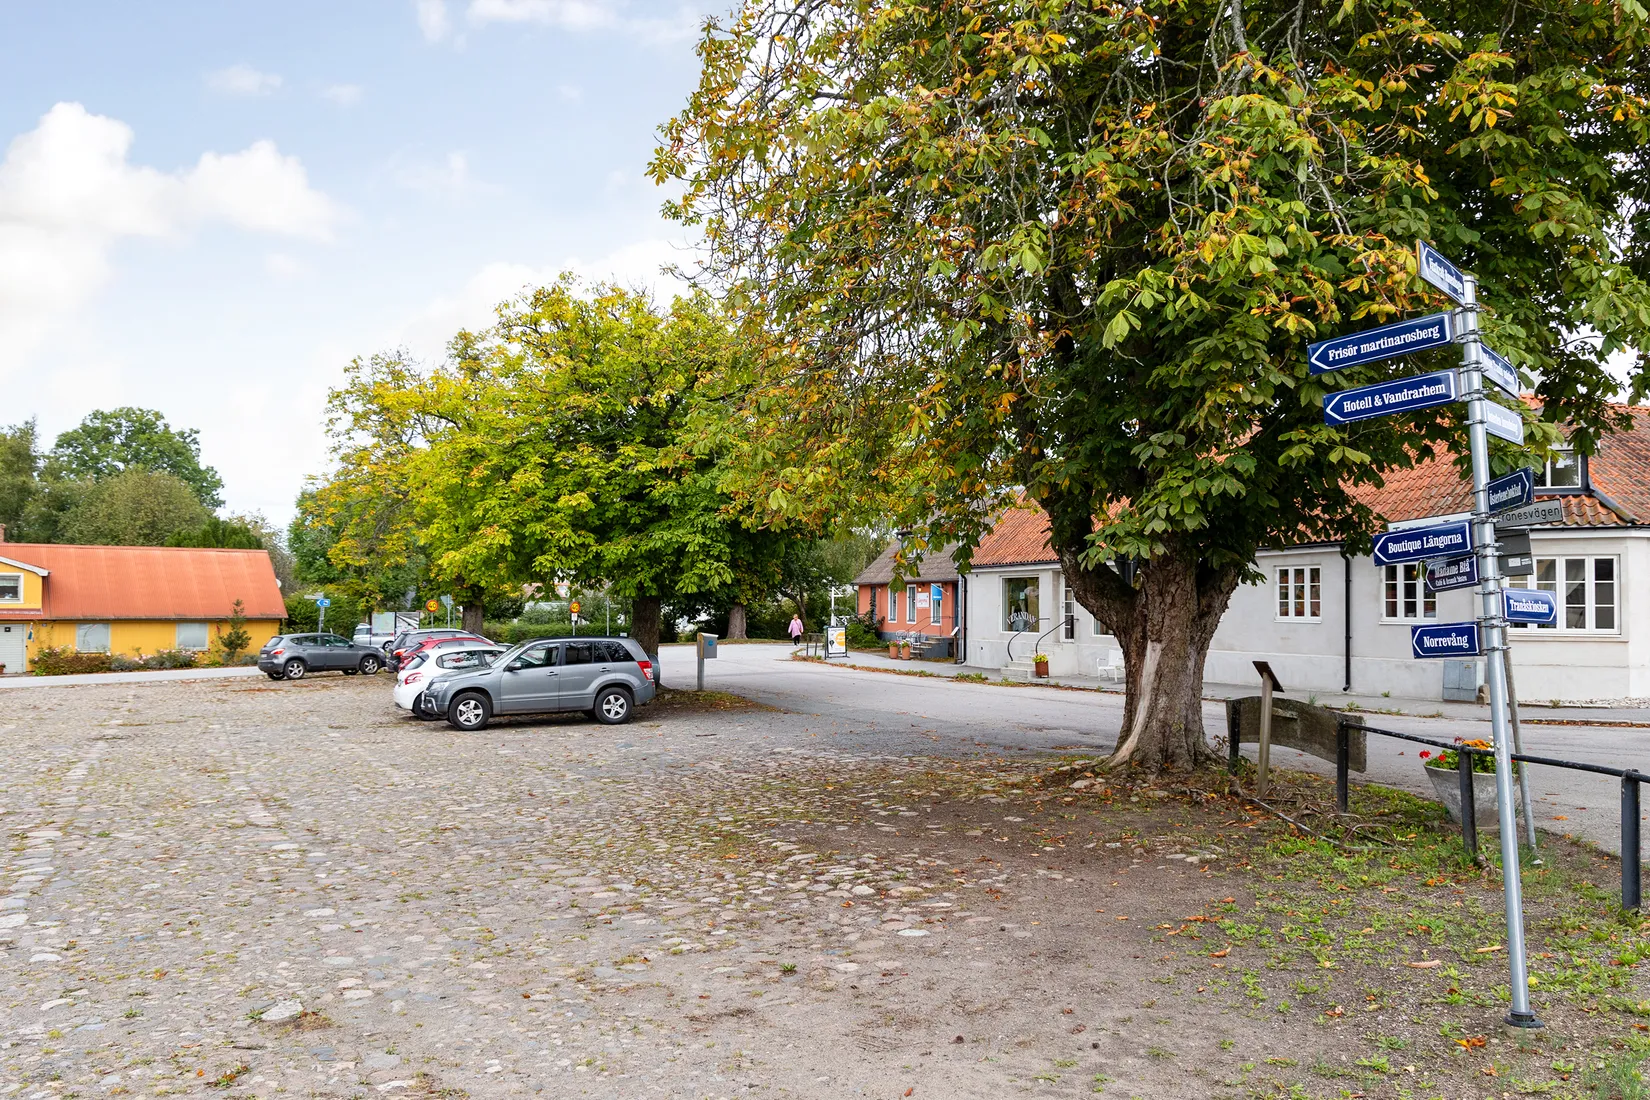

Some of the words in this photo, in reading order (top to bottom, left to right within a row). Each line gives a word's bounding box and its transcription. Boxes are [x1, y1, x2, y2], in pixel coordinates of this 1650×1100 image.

[1328, 345, 1358, 361] Frisör
[1360, 325, 1440, 354] martinarosberg
[1343, 396, 1372, 413] Hotell
[1373, 395, 1383, 407] &
[1382, 384, 1446, 405] Vandrarhem
[1499, 507, 1560, 522] ranesvägen
[1388, 540, 1422, 554] Boutique
[1423, 533, 1463, 549] Längorna
[1434, 564, 1459, 579] Madame
[1459, 558, 1471, 573] Blå
[1423, 632, 1469, 649] Norrevång
